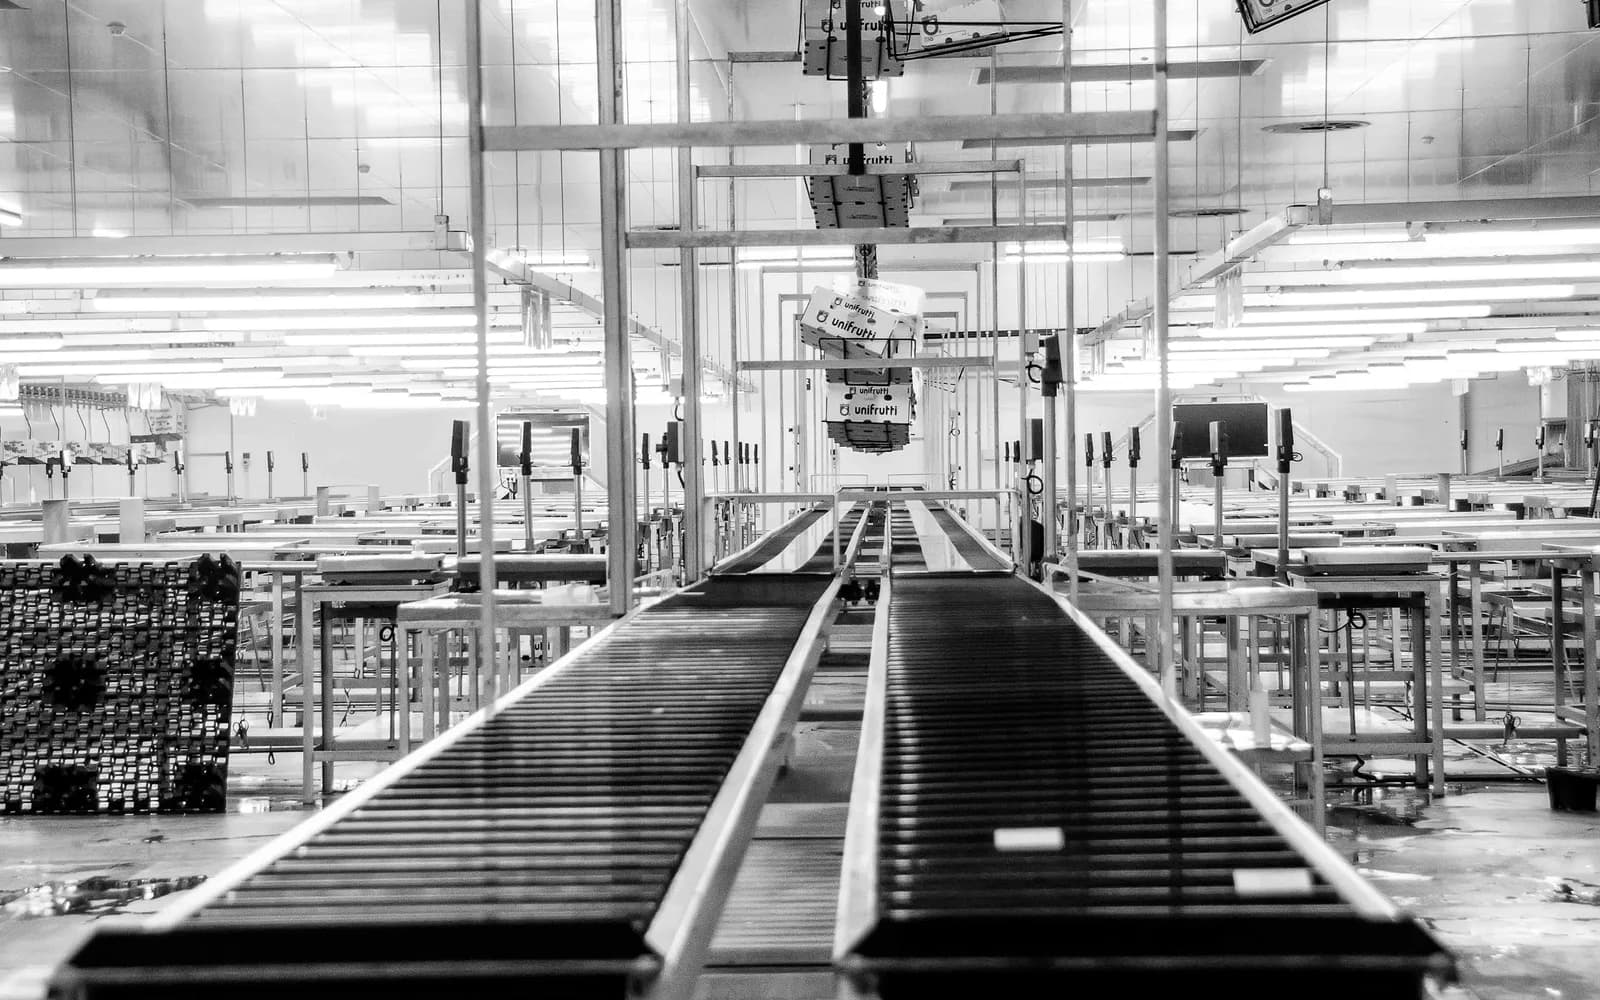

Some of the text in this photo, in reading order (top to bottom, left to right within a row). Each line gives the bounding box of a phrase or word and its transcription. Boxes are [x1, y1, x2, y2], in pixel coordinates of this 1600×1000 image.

[843, 154, 893, 165] urutti
[844, 302, 875, 318] unifrutti
[831, 318, 876, 340] unifrutti
[859, 387, 889, 395] unifrutti
[854, 403, 898, 416] unifrutti
